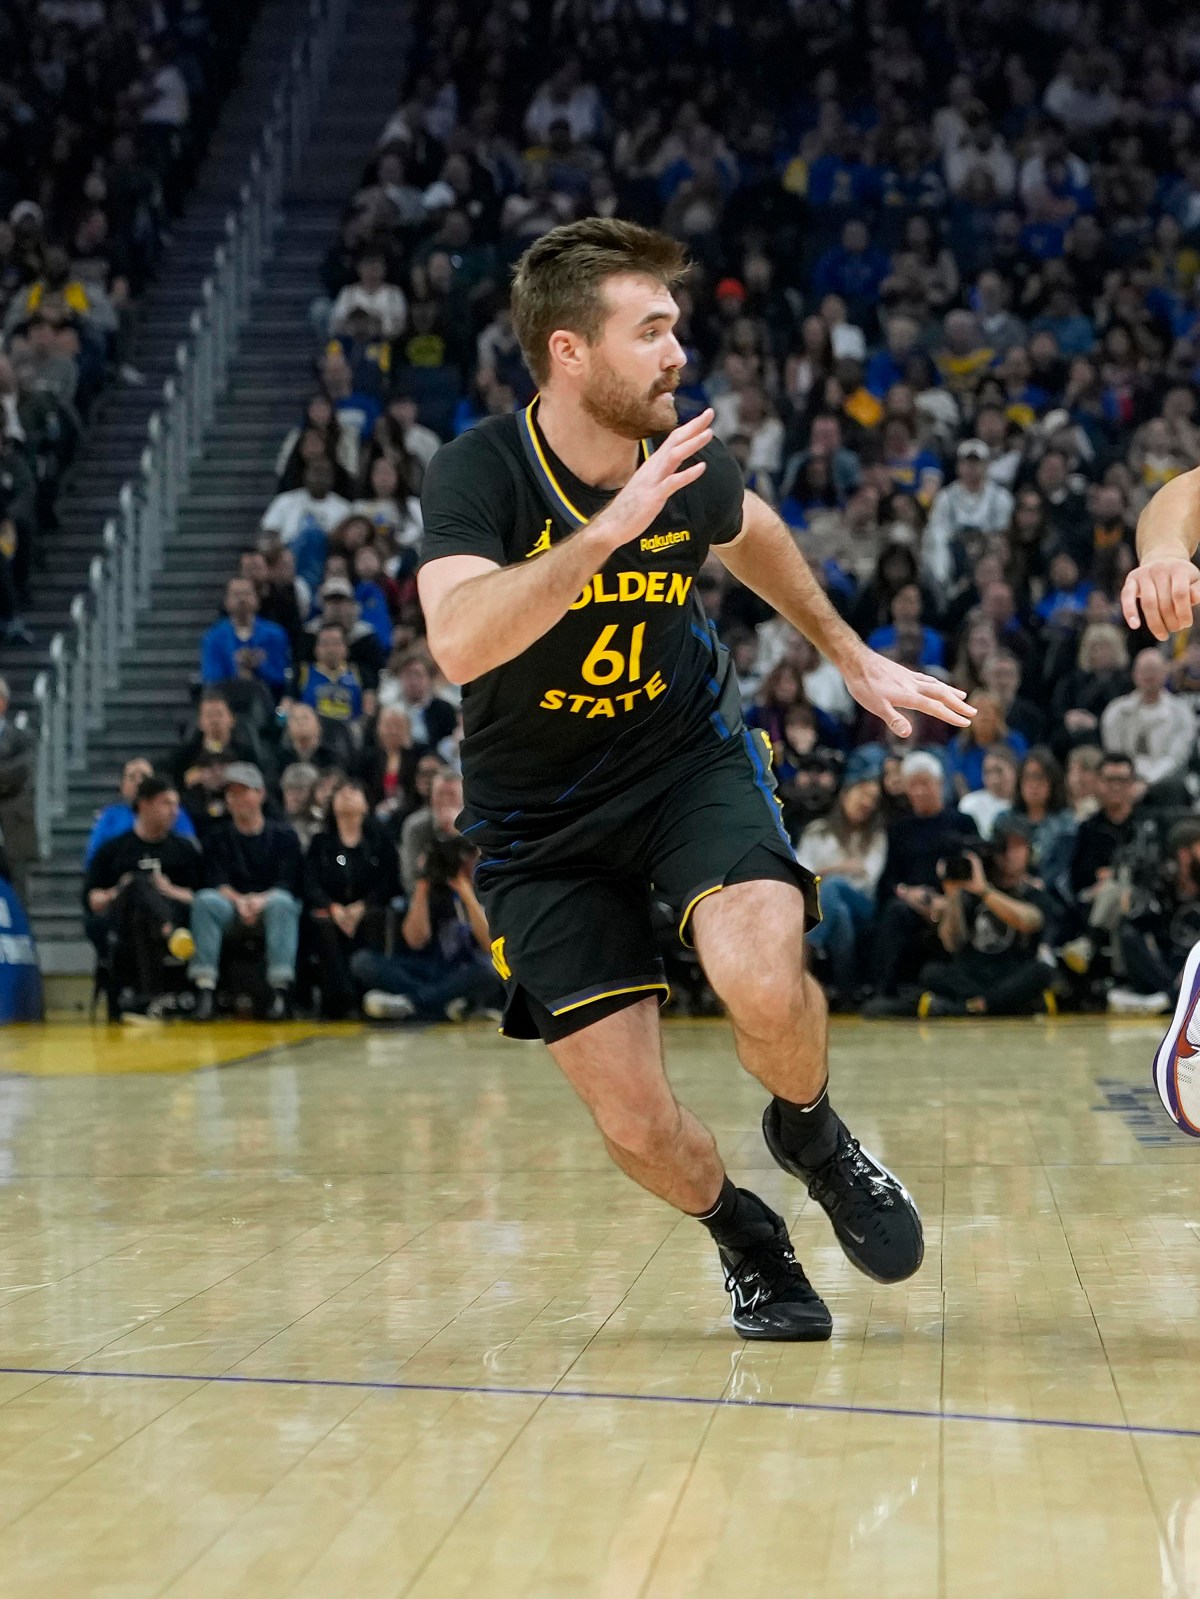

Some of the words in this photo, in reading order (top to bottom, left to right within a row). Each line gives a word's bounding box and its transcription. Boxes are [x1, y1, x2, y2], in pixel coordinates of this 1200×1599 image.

[640, 530, 690, 552] Rakuten
[581, 621, 647, 687] 61
[539, 670, 668, 719] STATE
